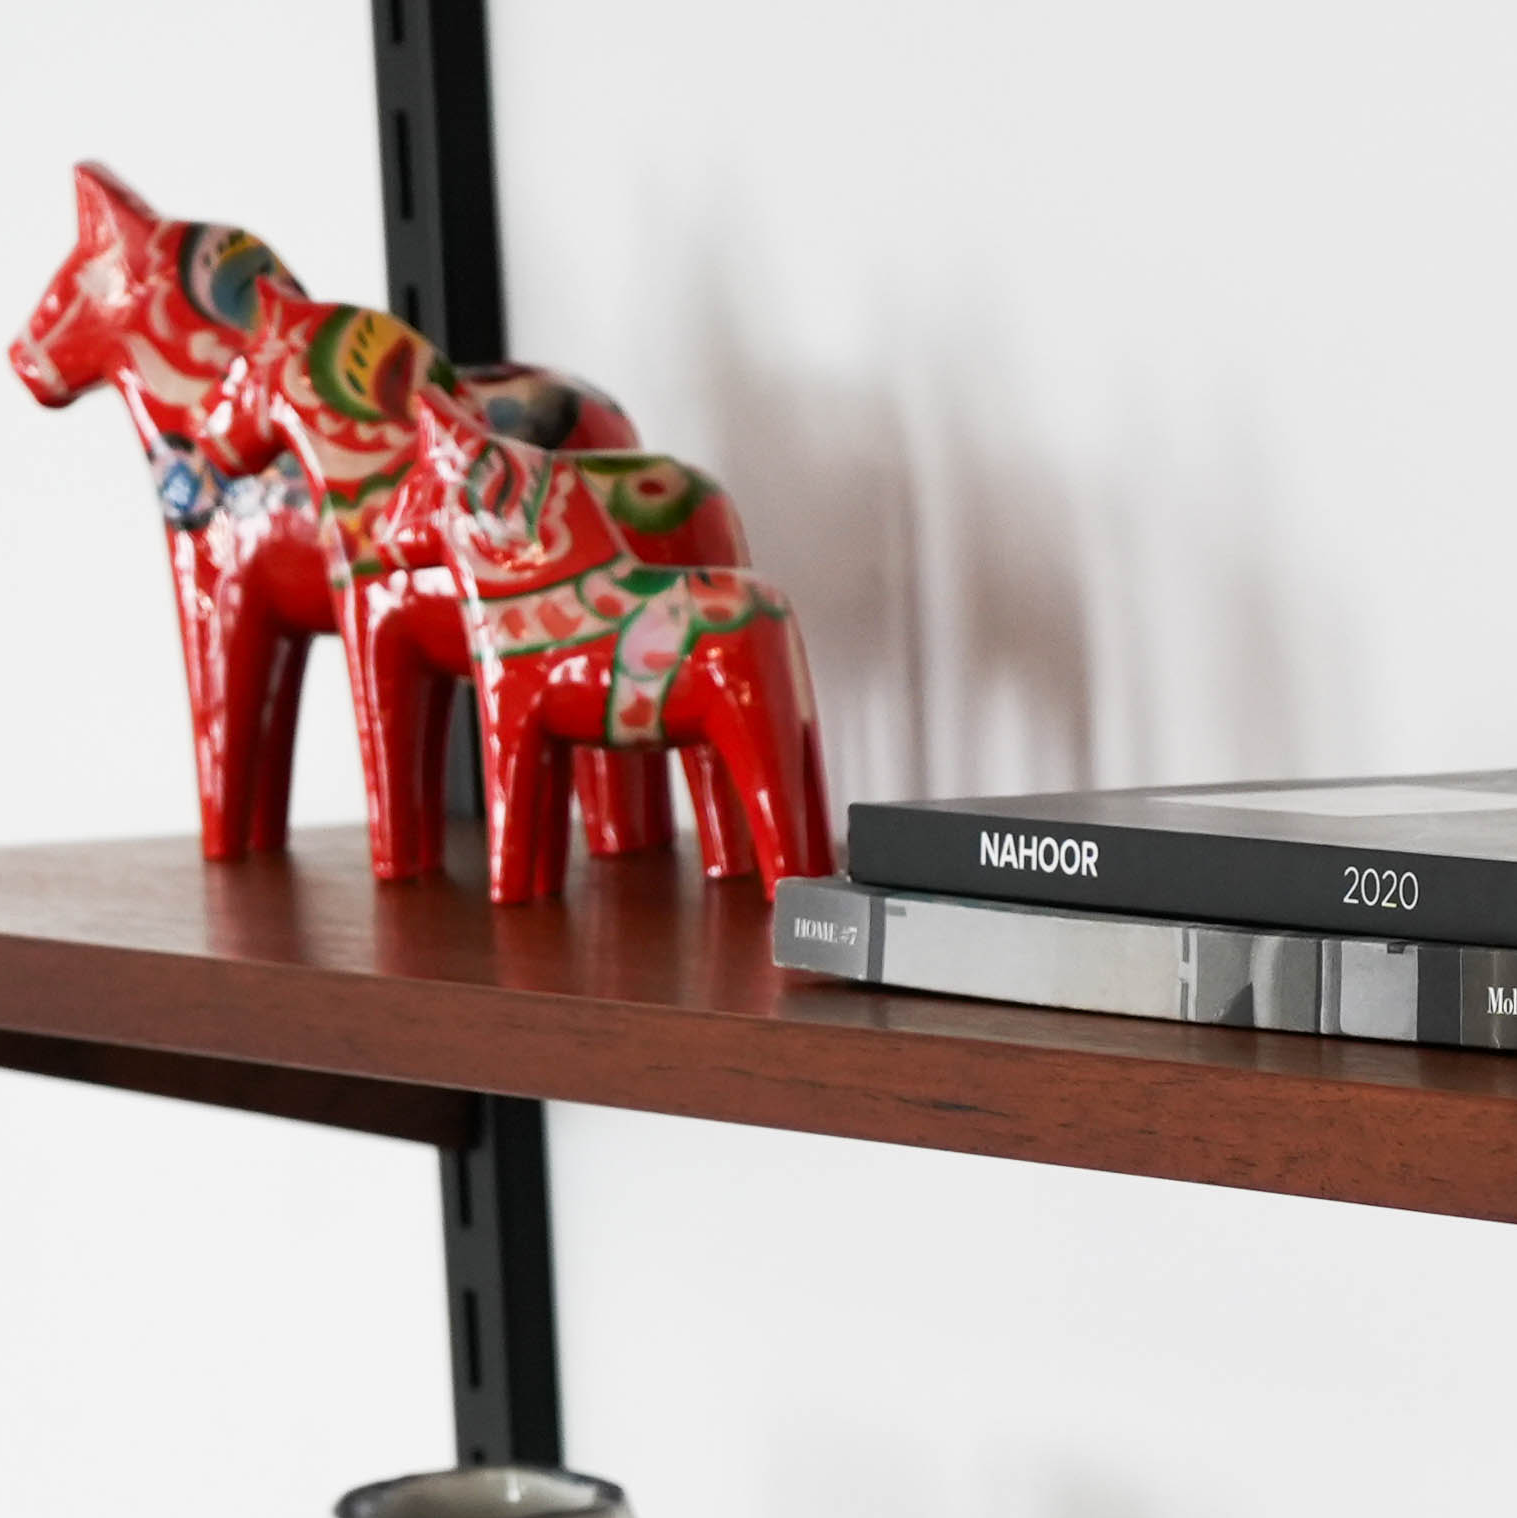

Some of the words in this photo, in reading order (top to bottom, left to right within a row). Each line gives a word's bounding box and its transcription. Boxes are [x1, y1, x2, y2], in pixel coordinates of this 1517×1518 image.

[980, 830, 1099, 877] NAHOOR
[1343, 866, 1419, 910] 2020
[794, 917, 839, 944] HOME
